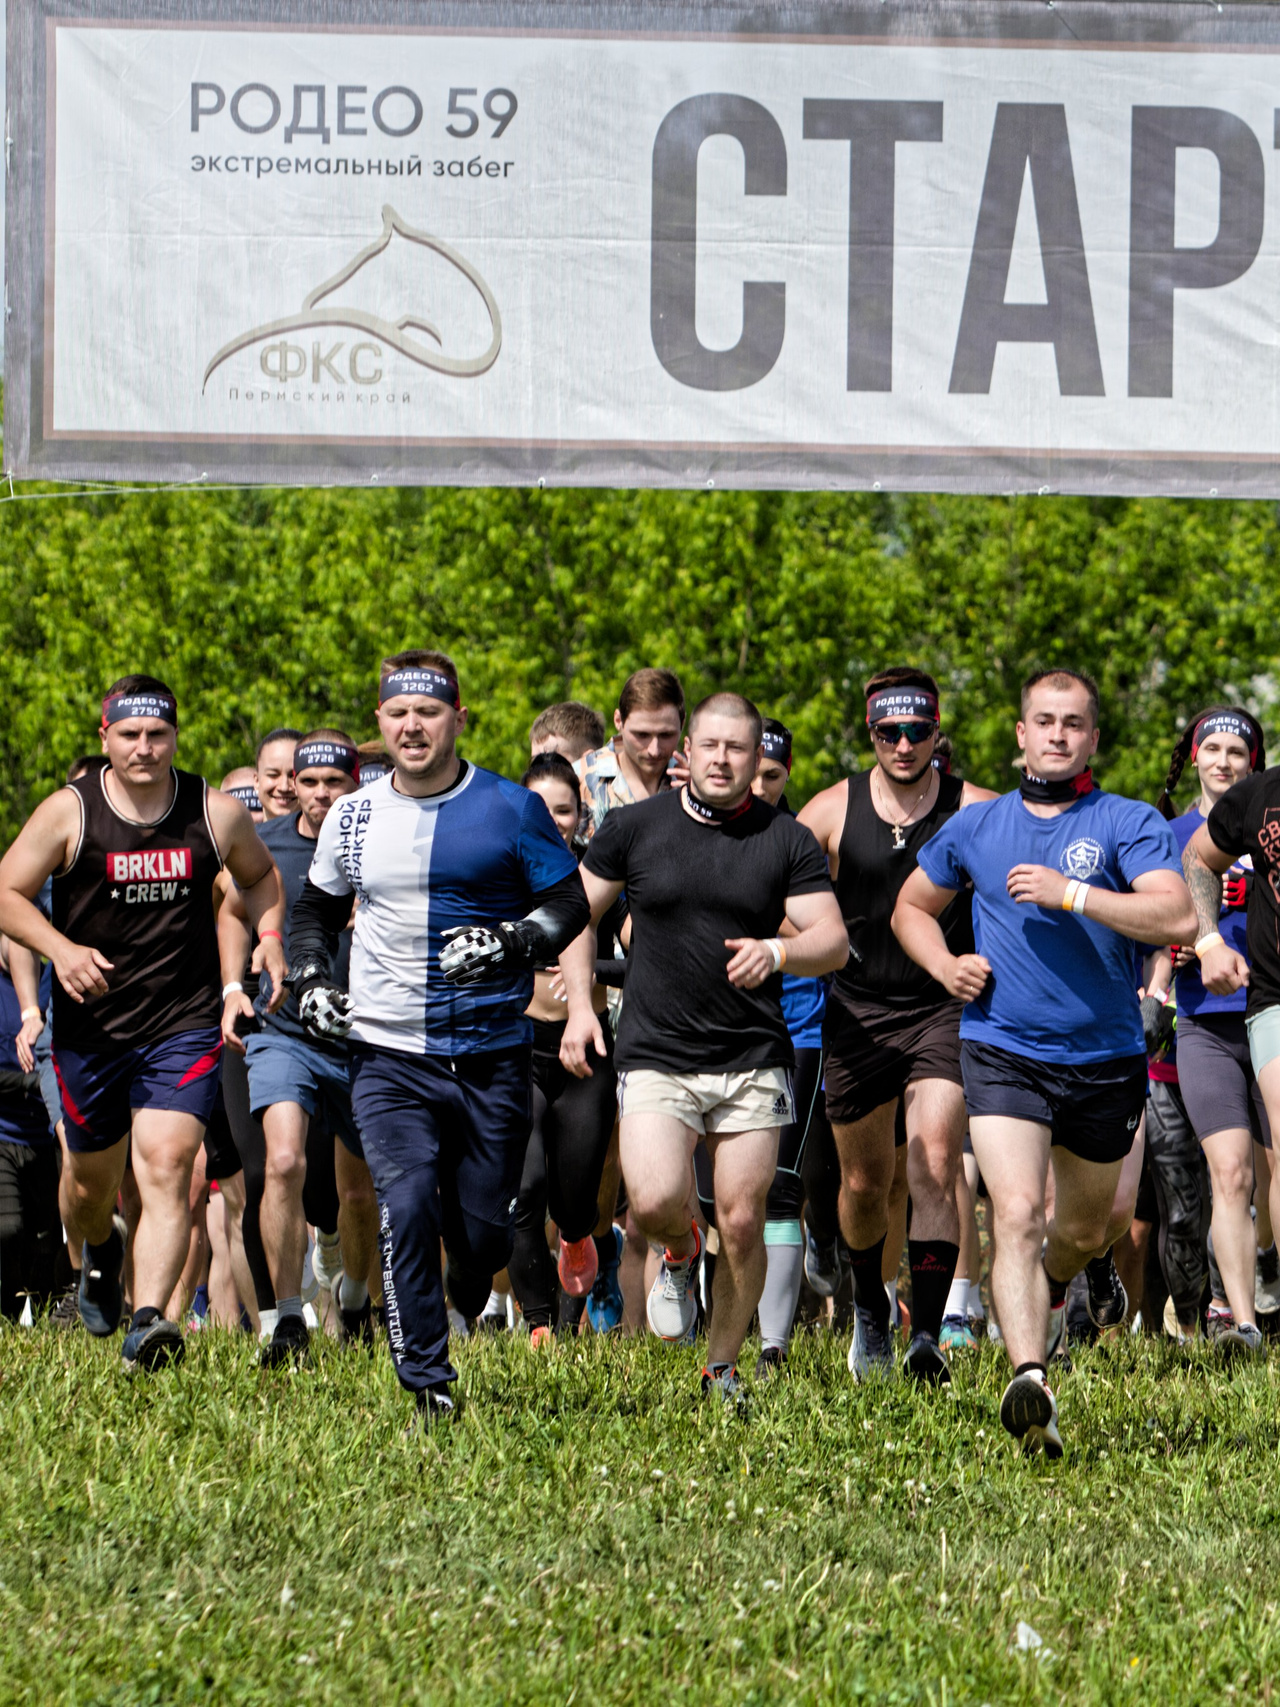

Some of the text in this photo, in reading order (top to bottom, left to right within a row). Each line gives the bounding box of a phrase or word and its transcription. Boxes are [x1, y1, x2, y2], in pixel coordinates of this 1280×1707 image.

[189, 81, 518, 144] РОДЕО 59
[190, 151, 515, 179] экстремальный забег
[259, 340, 383, 386] ФКС
[229, 386, 411, 405] Пермский край
[387, 671, 431, 684] РОДЕО
[401, 682, 433, 693] 3262
[117, 697, 157, 708] РОДЕО
[876, 695, 911, 708] РОДЕО
[1203, 715, 1239, 730] РОДЕО
[298, 744, 332, 758] РОДЕО
[113, 851, 187, 881] BRKLN
[125, 882, 178, 904] CREW
